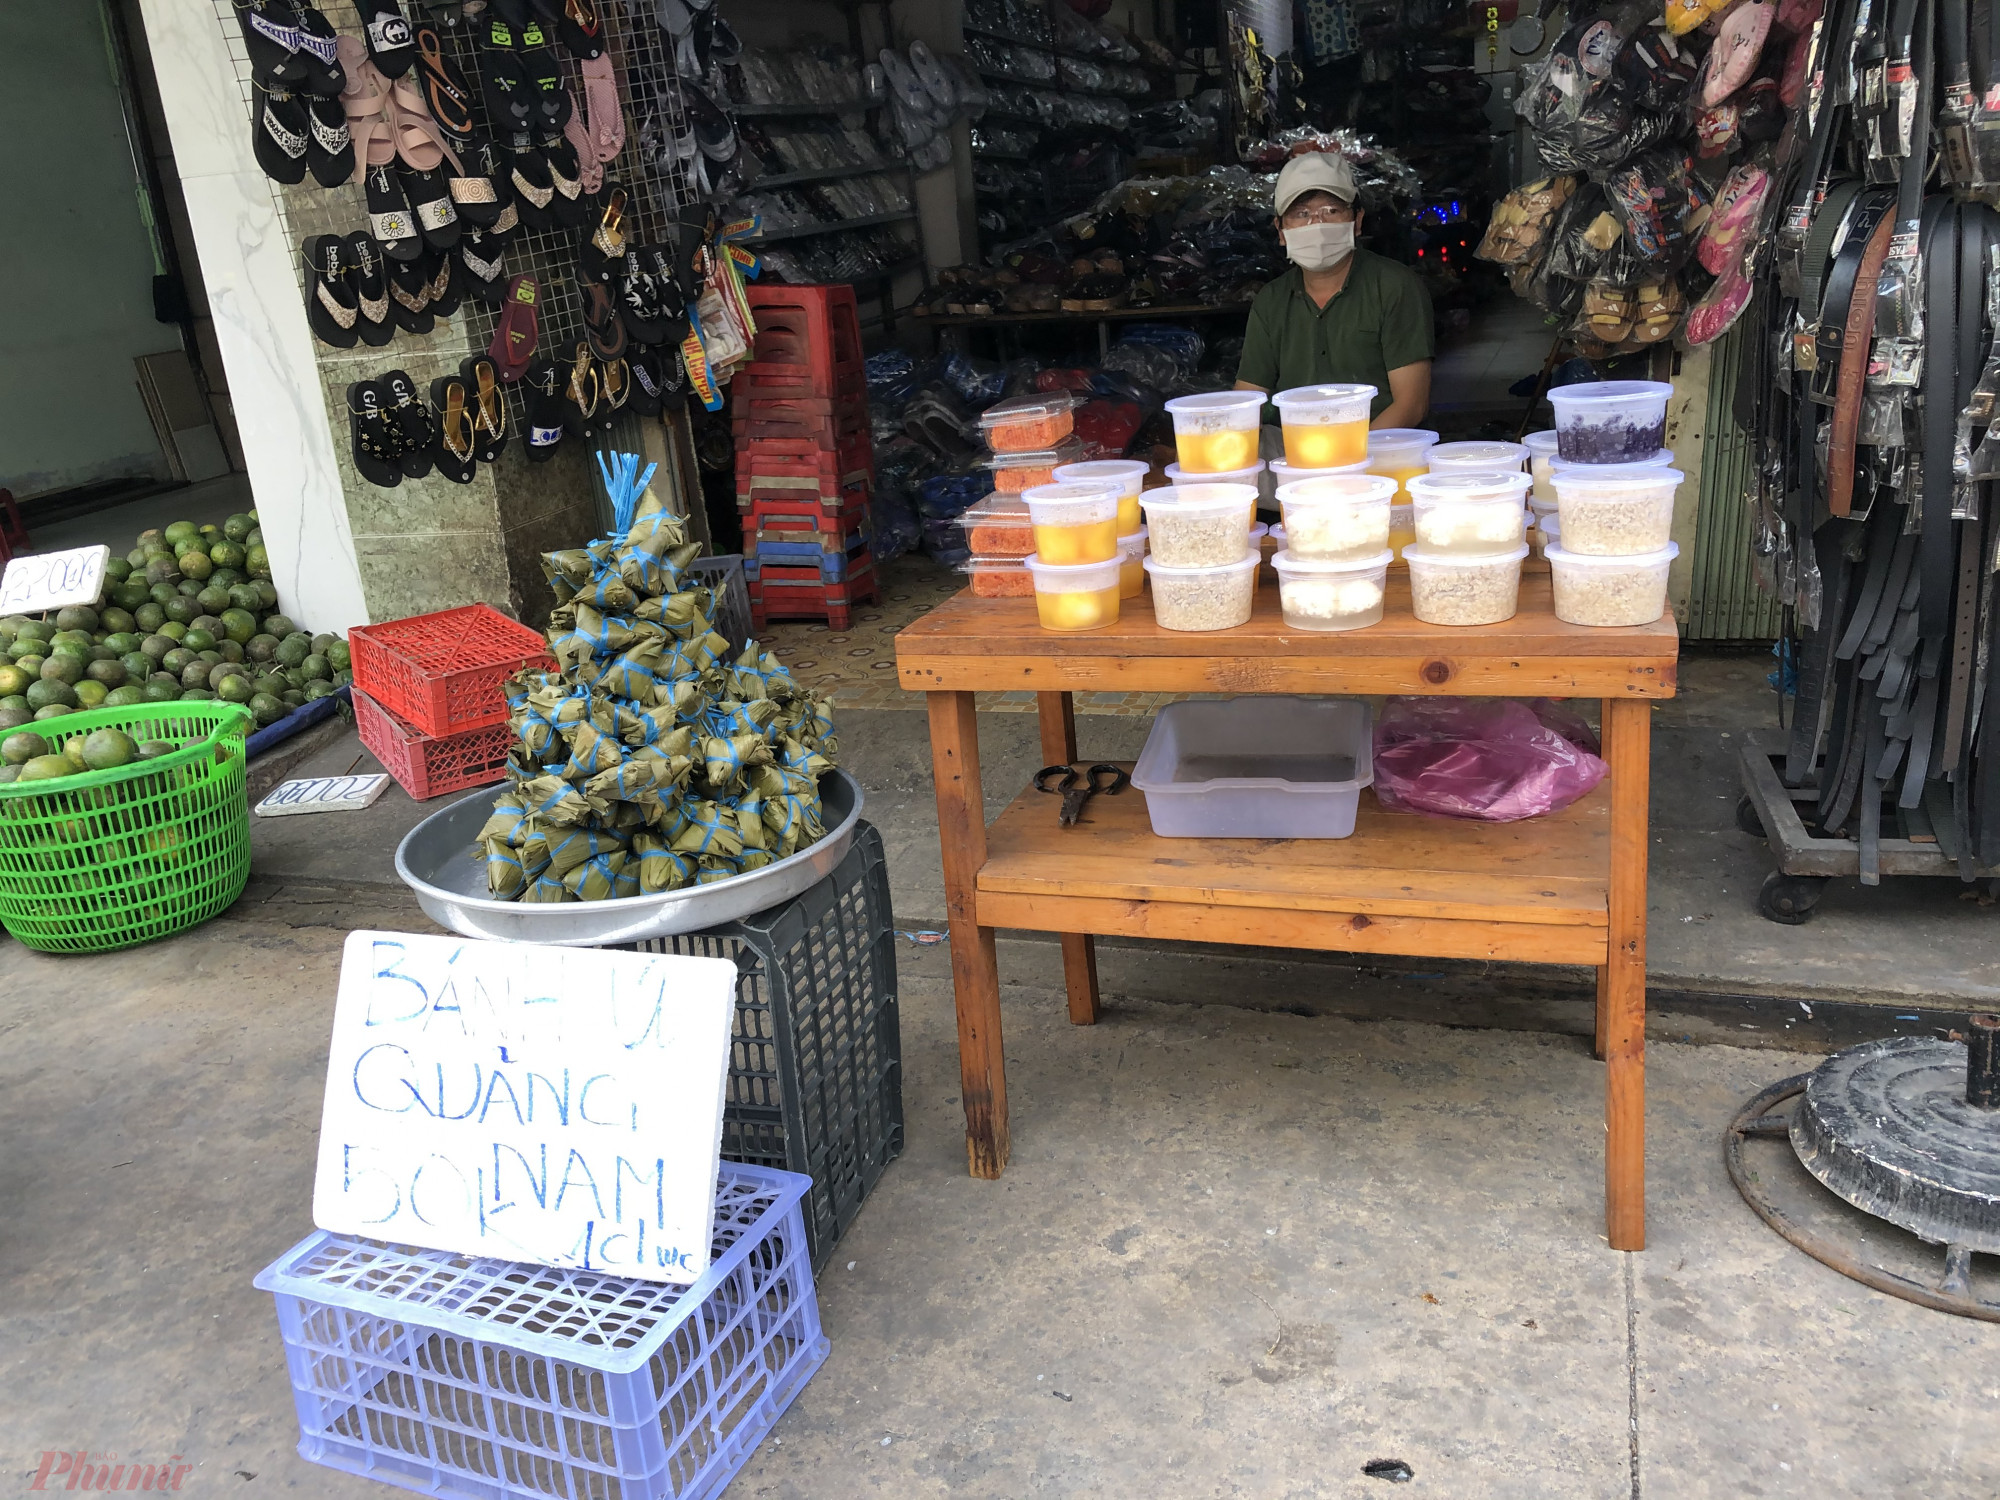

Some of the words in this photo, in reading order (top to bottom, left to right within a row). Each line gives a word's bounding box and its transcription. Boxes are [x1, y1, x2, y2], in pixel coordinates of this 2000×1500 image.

[329, 245, 339, 276] bebe
[359, 240, 373, 272] bebe
[492, 1142, 666, 1230] NAM
